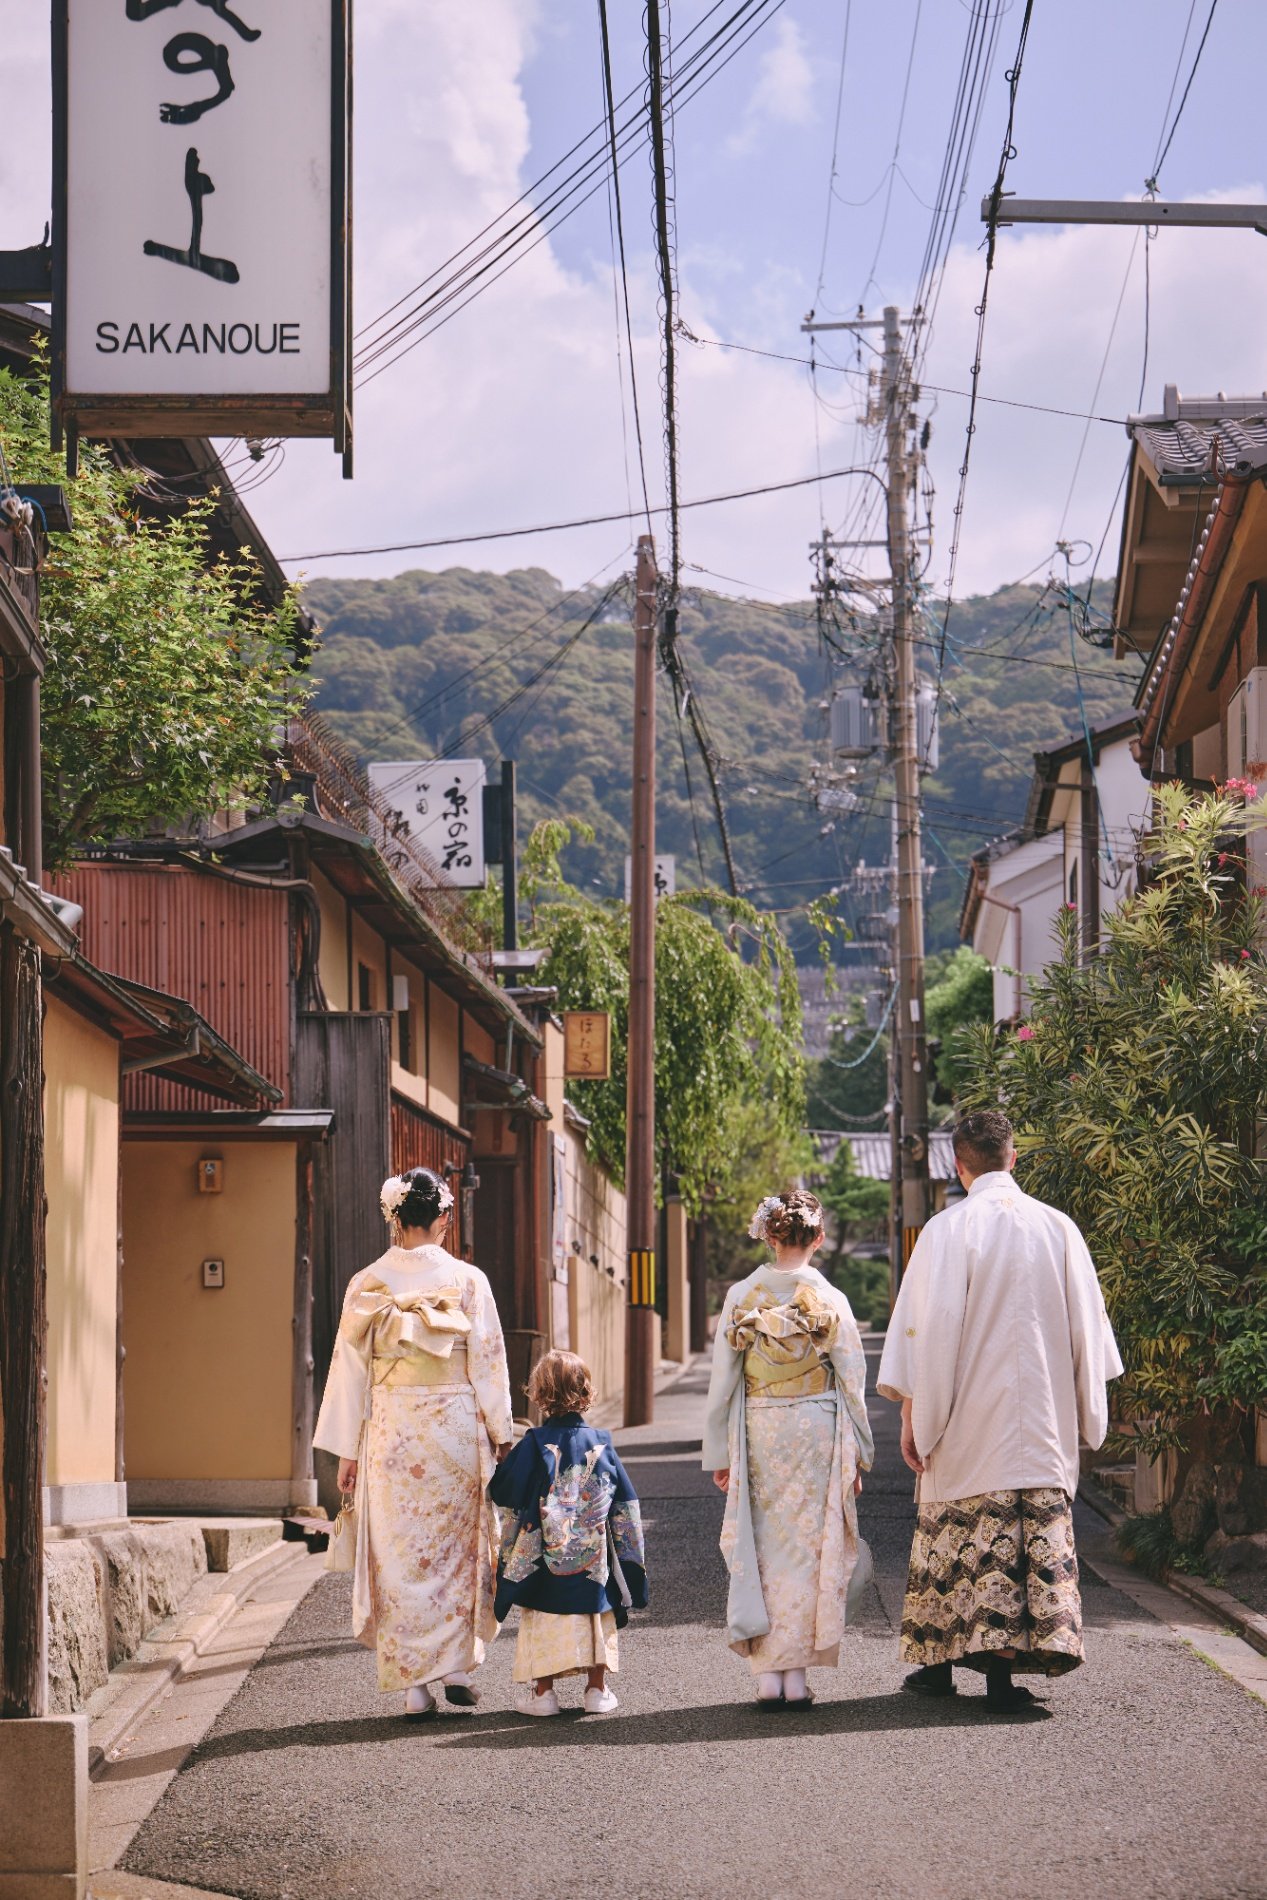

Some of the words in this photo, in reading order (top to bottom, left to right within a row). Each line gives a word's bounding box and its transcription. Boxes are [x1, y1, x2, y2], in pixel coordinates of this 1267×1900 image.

[95, 321, 301, 355] SAKANOUE
[441, 776, 472, 871] 京の宿
